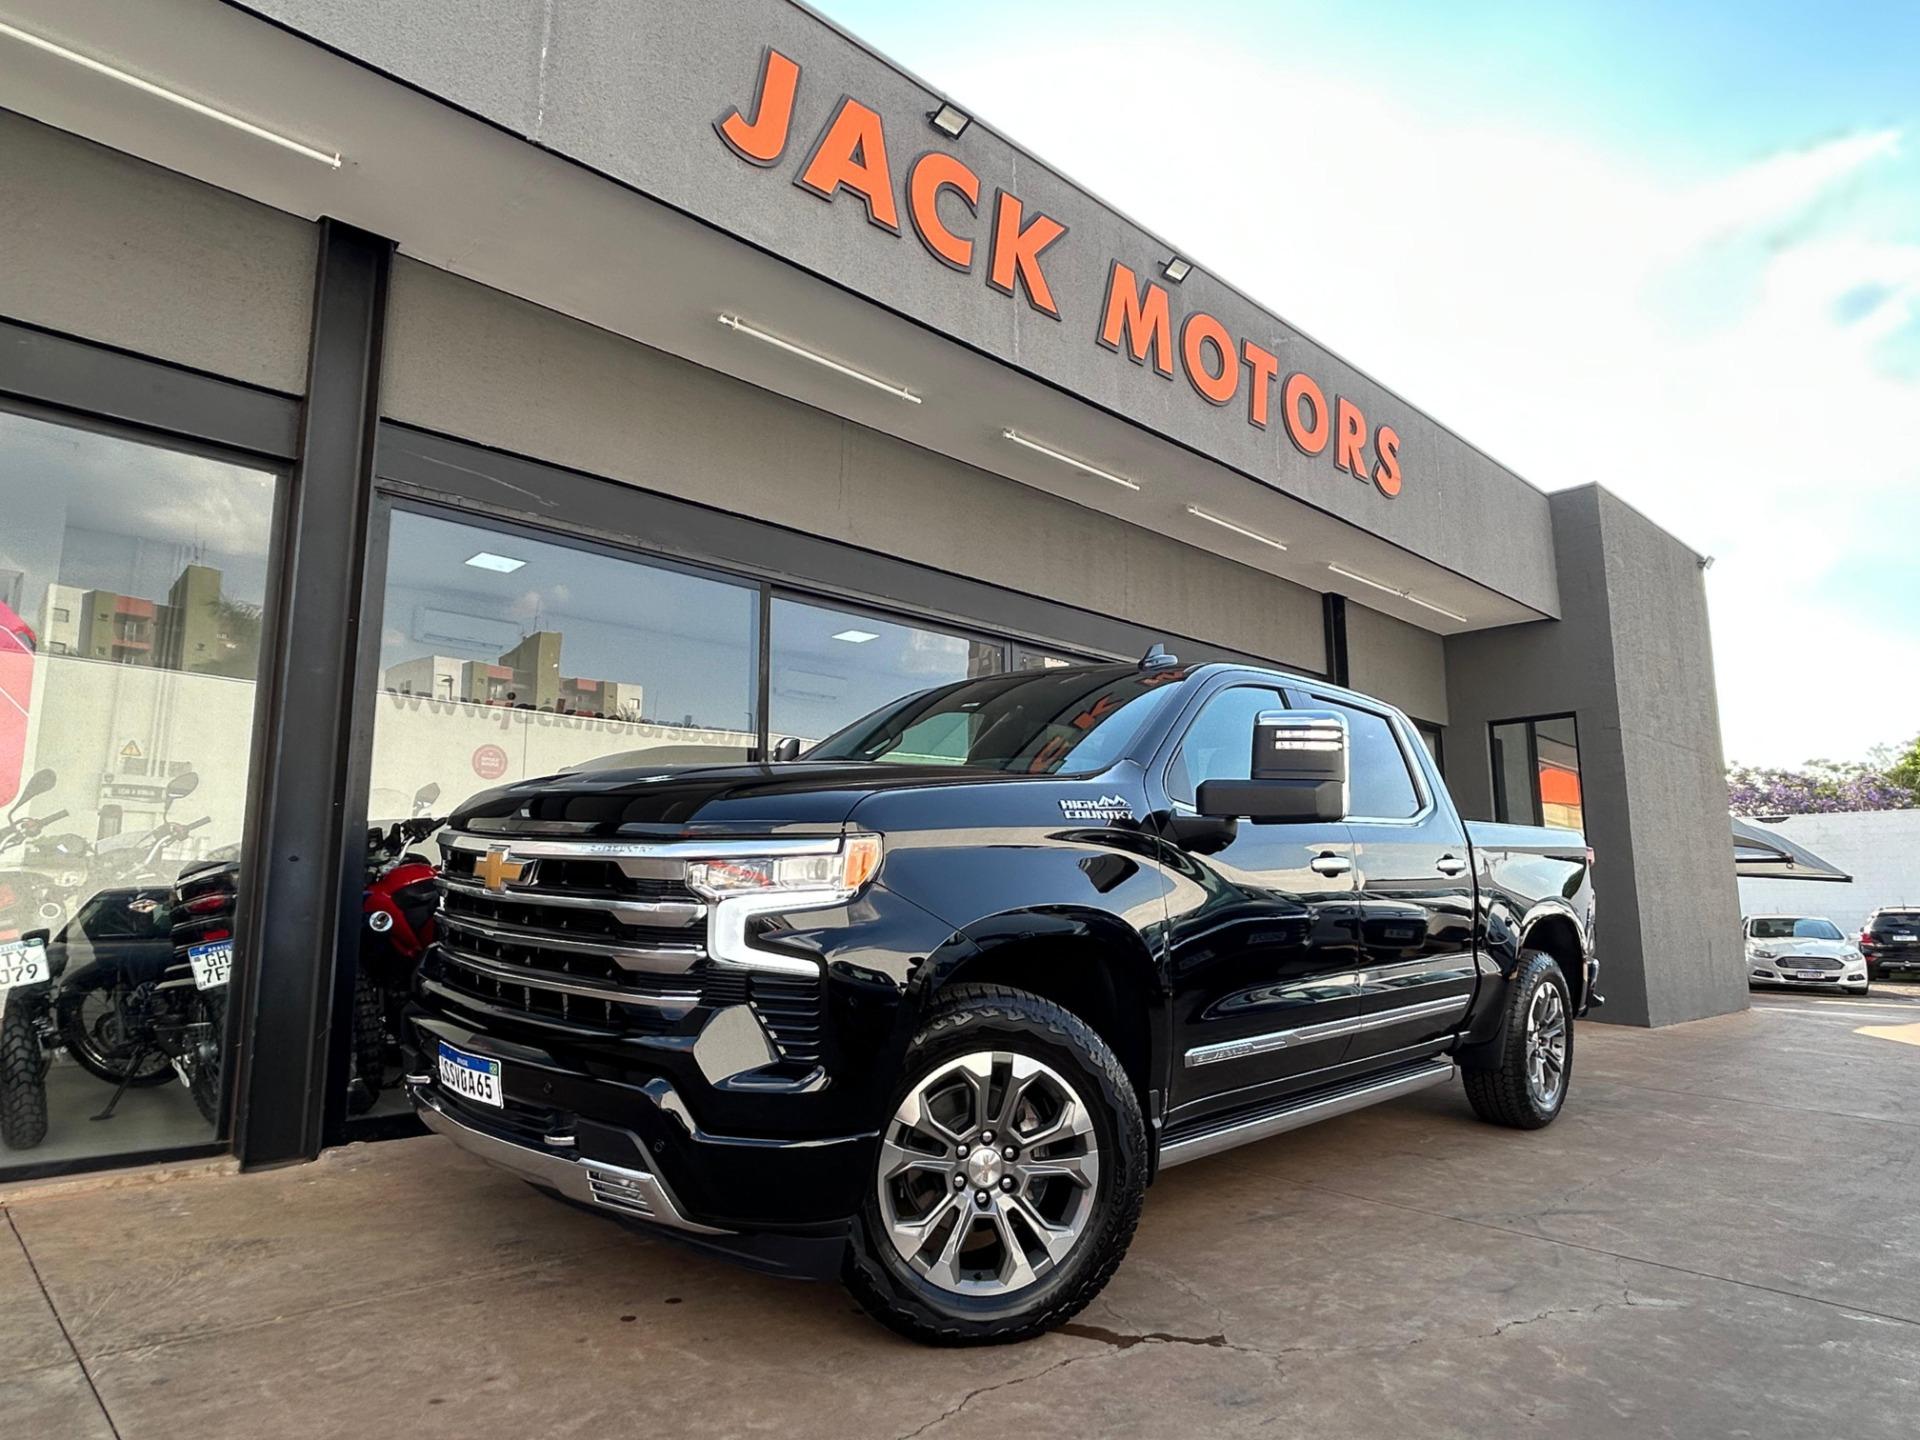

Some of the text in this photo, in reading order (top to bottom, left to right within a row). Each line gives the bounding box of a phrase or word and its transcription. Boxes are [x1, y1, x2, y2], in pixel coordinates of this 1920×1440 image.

[714, 46, 1402, 499] JACK MOTORS
[1060, 800, 1101, 809] HIGH
[1064, 810, 1133, 820] COUNTRY
